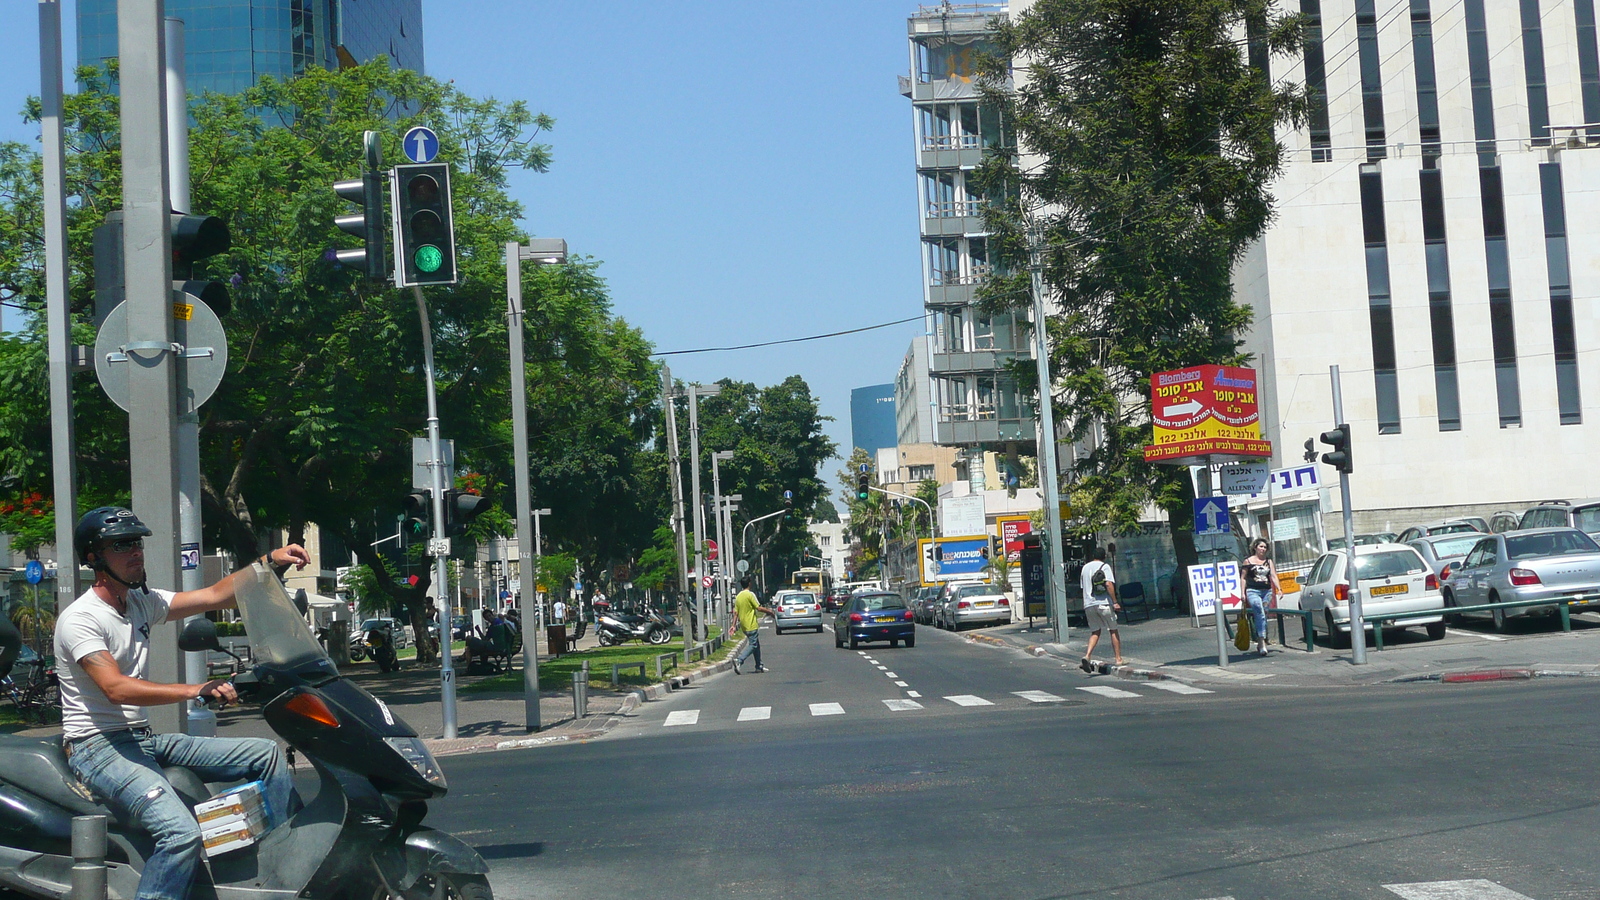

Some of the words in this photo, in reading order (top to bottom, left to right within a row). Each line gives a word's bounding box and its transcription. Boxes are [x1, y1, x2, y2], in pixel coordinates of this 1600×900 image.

[1156, 384, 1181, 397] סופר
[1183, 380, 1204, 393] אבי
[1212, 389, 1235, 402] סופר
[1237, 391, 1254, 404] אבי
[1159, 433, 1177, 443] 122
[1180, 427, 1207, 440] אלנבי
[1217, 429, 1231, 438] 122
[1233, 428, 1255, 439] אלנבי
[1196, 440, 1214, 451] אלנבי
[1226, 467, 1252, 476] אלנבי
[1227, 484, 1256, 492] ALLENBY
[1192, 564, 1236, 580] כנסה
